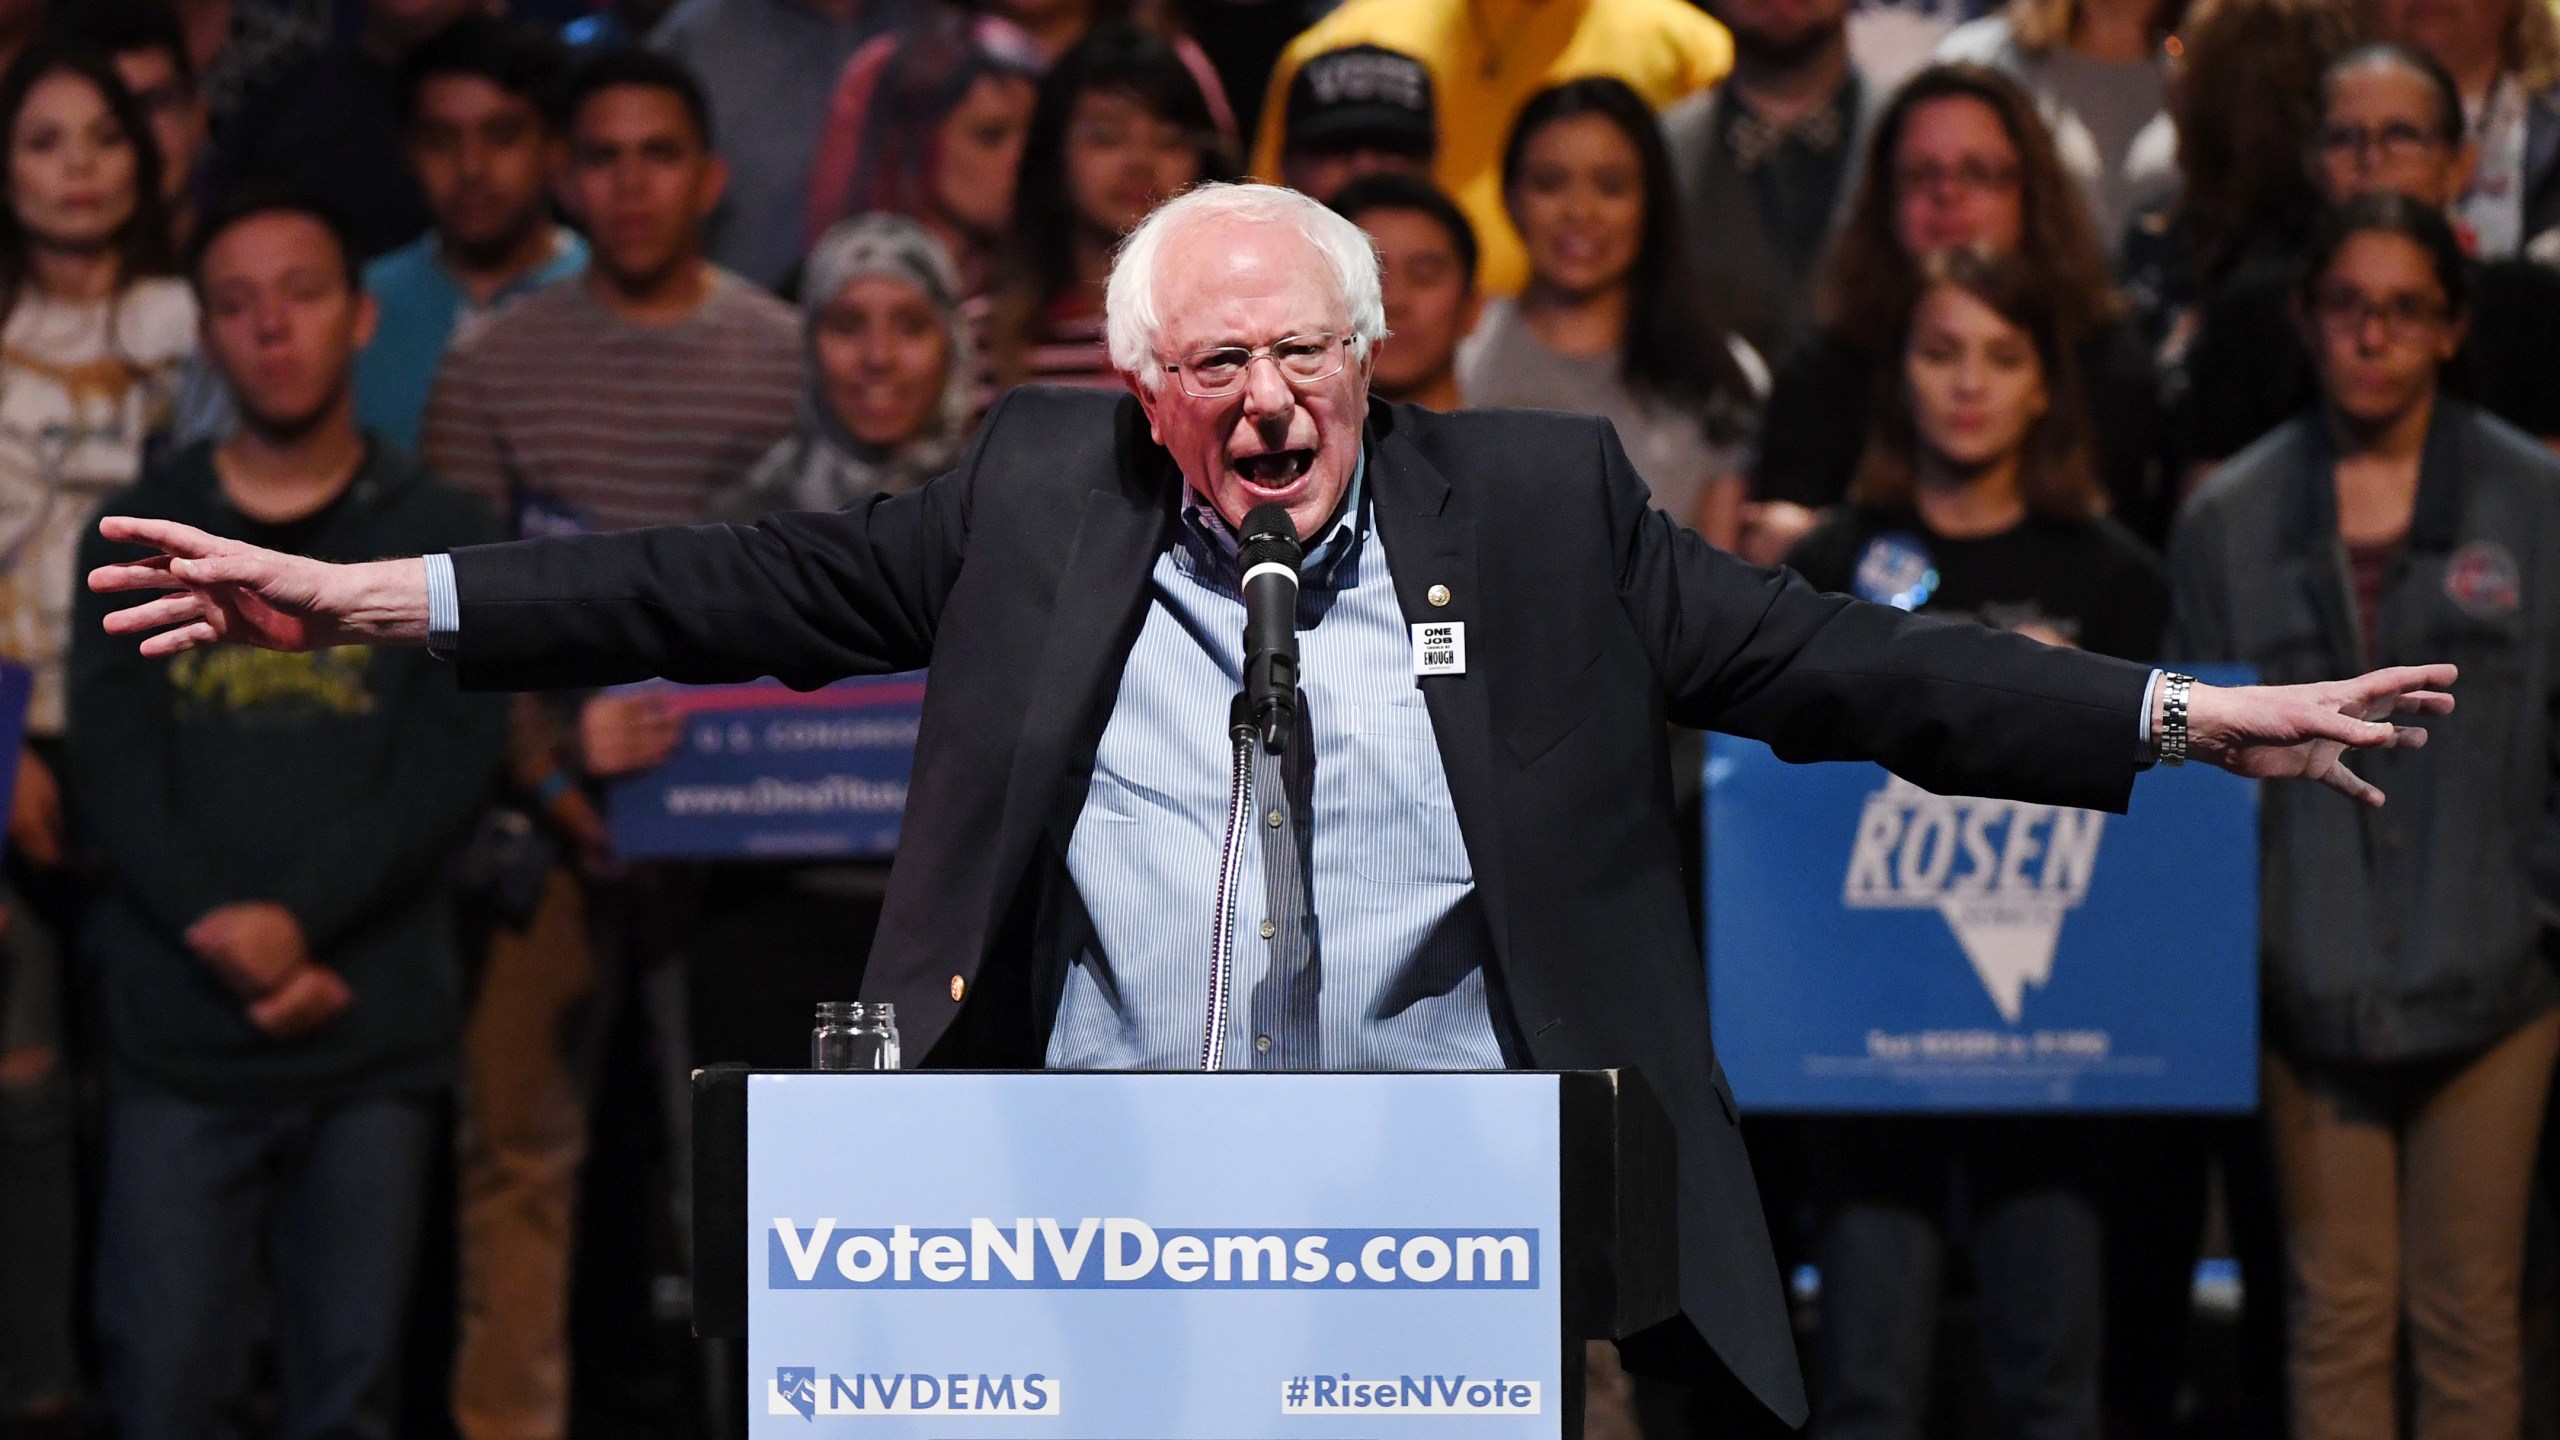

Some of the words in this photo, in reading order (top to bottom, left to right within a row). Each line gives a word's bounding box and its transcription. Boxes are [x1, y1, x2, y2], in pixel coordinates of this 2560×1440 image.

[1424, 627, 1452, 637] ONE
[1424, 637, 1453, 645] JOB
[1424, 650, 1454, 665] ENOUGH
[1845, 794, 2107, 897] ROSEN
[772, 1217, 1531, 1283] VoteNVDems.com
[829, 1373, 1048, 1411] NVDEMS
[1286, 1373, 1532, 1408] #RiseNVote
